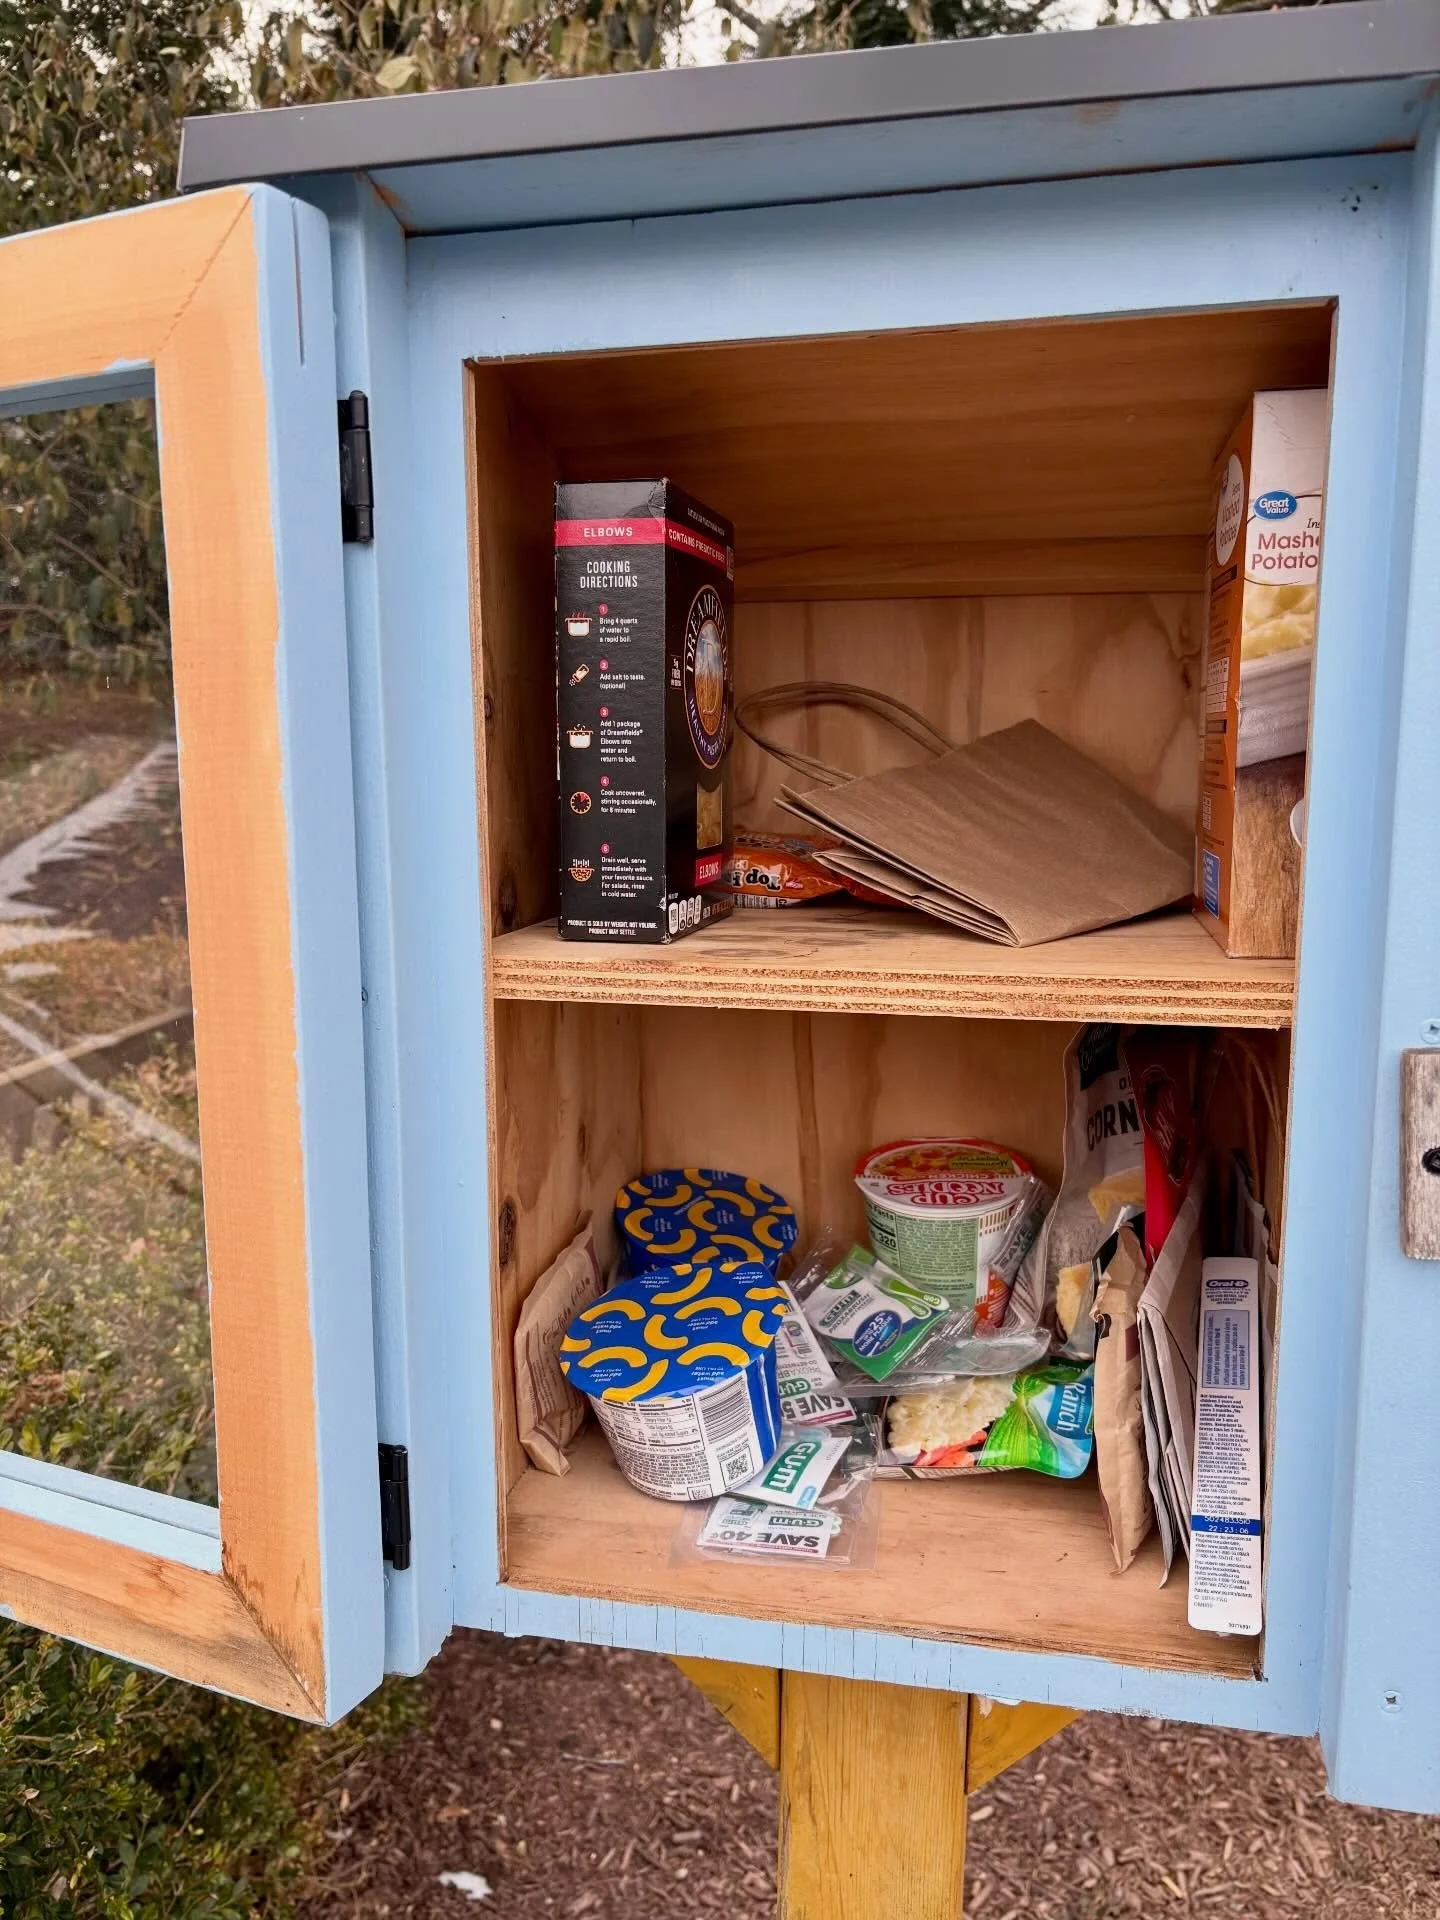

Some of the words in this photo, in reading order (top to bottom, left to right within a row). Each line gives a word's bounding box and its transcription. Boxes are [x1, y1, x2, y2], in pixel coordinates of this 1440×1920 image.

[1259, 497, 1289, 508] Great
[1266, 506, 1289, 514] Value
[583, 527, 633, 537] ELBOWS
[668, 528, 695, 548] CONTAINS
[587, 561, 630, 574] COOKING
[1251, 551, 1318, 570] Potato
[579, 575, 638, 588] DIRECTIONS
[600, 682, 625, 690] (optional)
[600, 798, 619, 806] stirring
[601, 856, 616, 864] Drain
[699, 861, 719, 879] ELBOWS
[1087, 1099, 1140, 1152] CORN
[887, 1181, 1003, 1195] NOODLES
[912, 1193, 977, 1206] CUP
[874, 1206, 894, 1220] Facts
[878, 1233, 896, 1248] 320
[859, 1336, 875, 1352] MORE
[872, 1314, 893, 1337] PLAQUE
[782, 1401, 797, 1419] 5
[797, 1395, 845, 1416] SAVE
[1057, 1383, 1086, 1433] Ranch
[758, 1532, 820, 1548] SAVE
